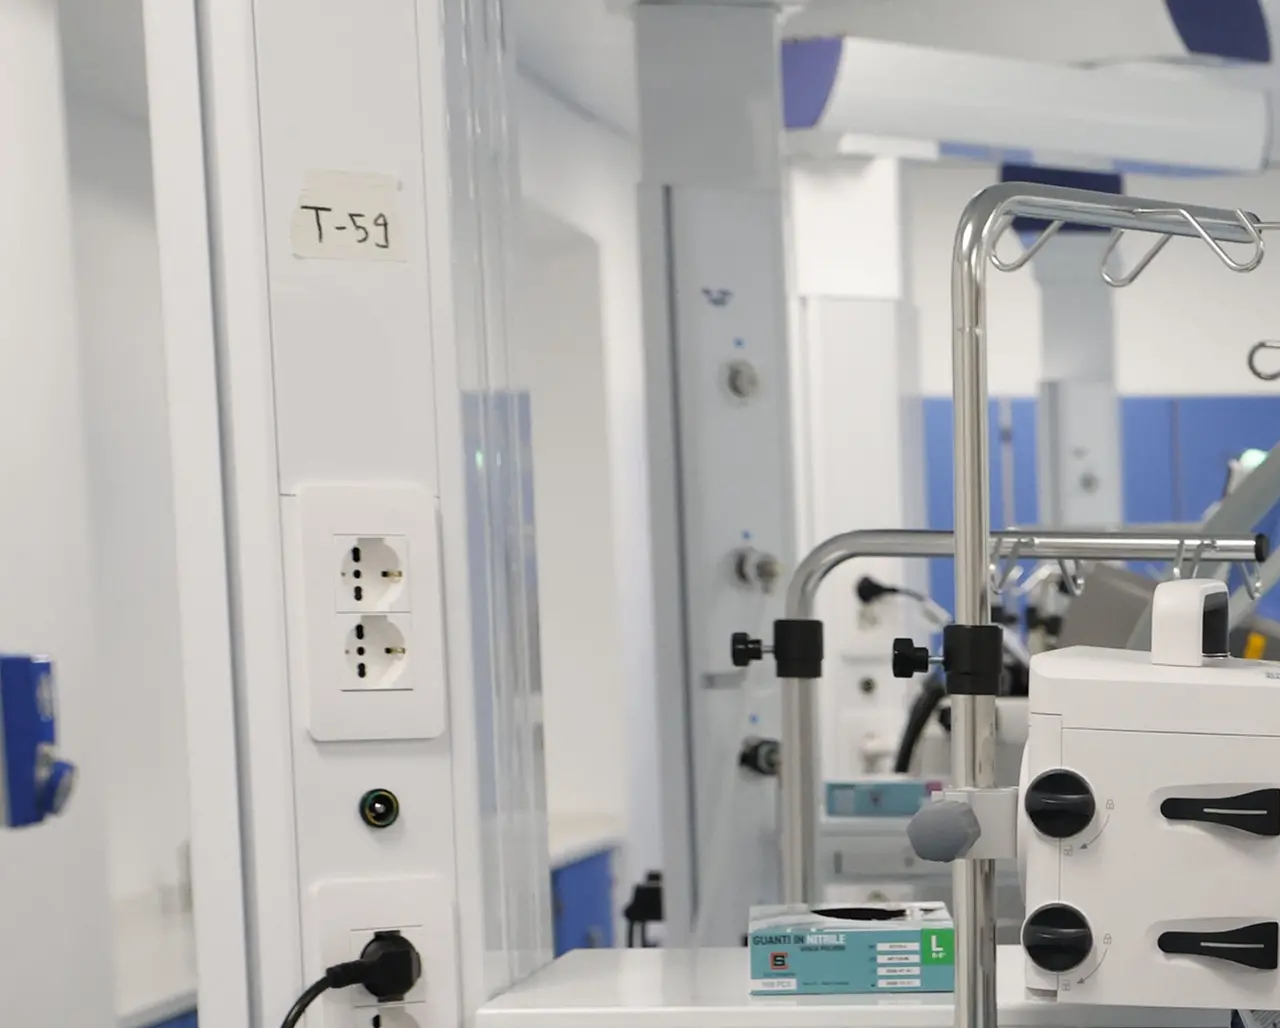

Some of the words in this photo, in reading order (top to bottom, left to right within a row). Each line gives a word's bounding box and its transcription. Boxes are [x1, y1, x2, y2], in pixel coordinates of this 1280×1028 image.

[300, 205, 389, 249] T-59
[752, 933, 791, 946] GUANTI
[793, 934, 804, 945] IN
[806, 933, 847, 945] NITRILE
[931, 935, 943, 952] L
